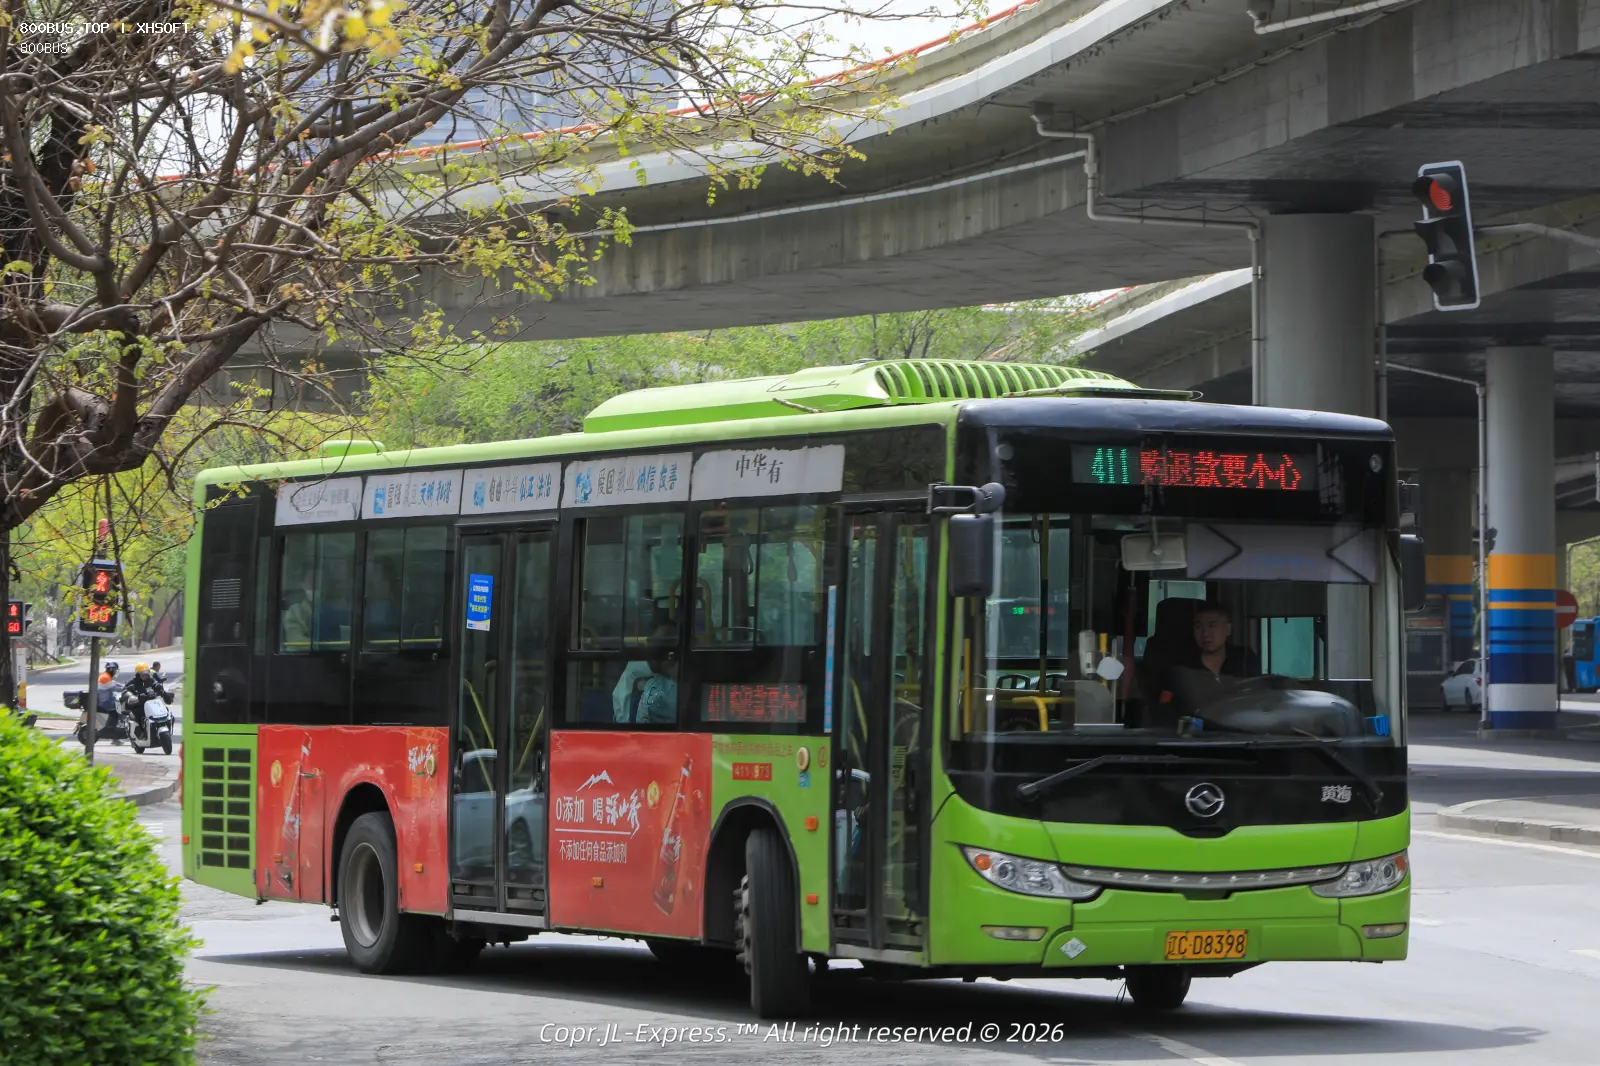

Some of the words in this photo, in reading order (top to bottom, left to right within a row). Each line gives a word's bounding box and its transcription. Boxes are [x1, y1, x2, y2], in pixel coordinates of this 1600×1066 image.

[735, 452, 784, 484] 中华有
[1091, 447, 1130, 485] 411
[1320, 784, 1353, 804] 黄海
[555, 795, 585, 824] 0添加
[558, 839, 628, 864] 不添加任何食品添加剂
